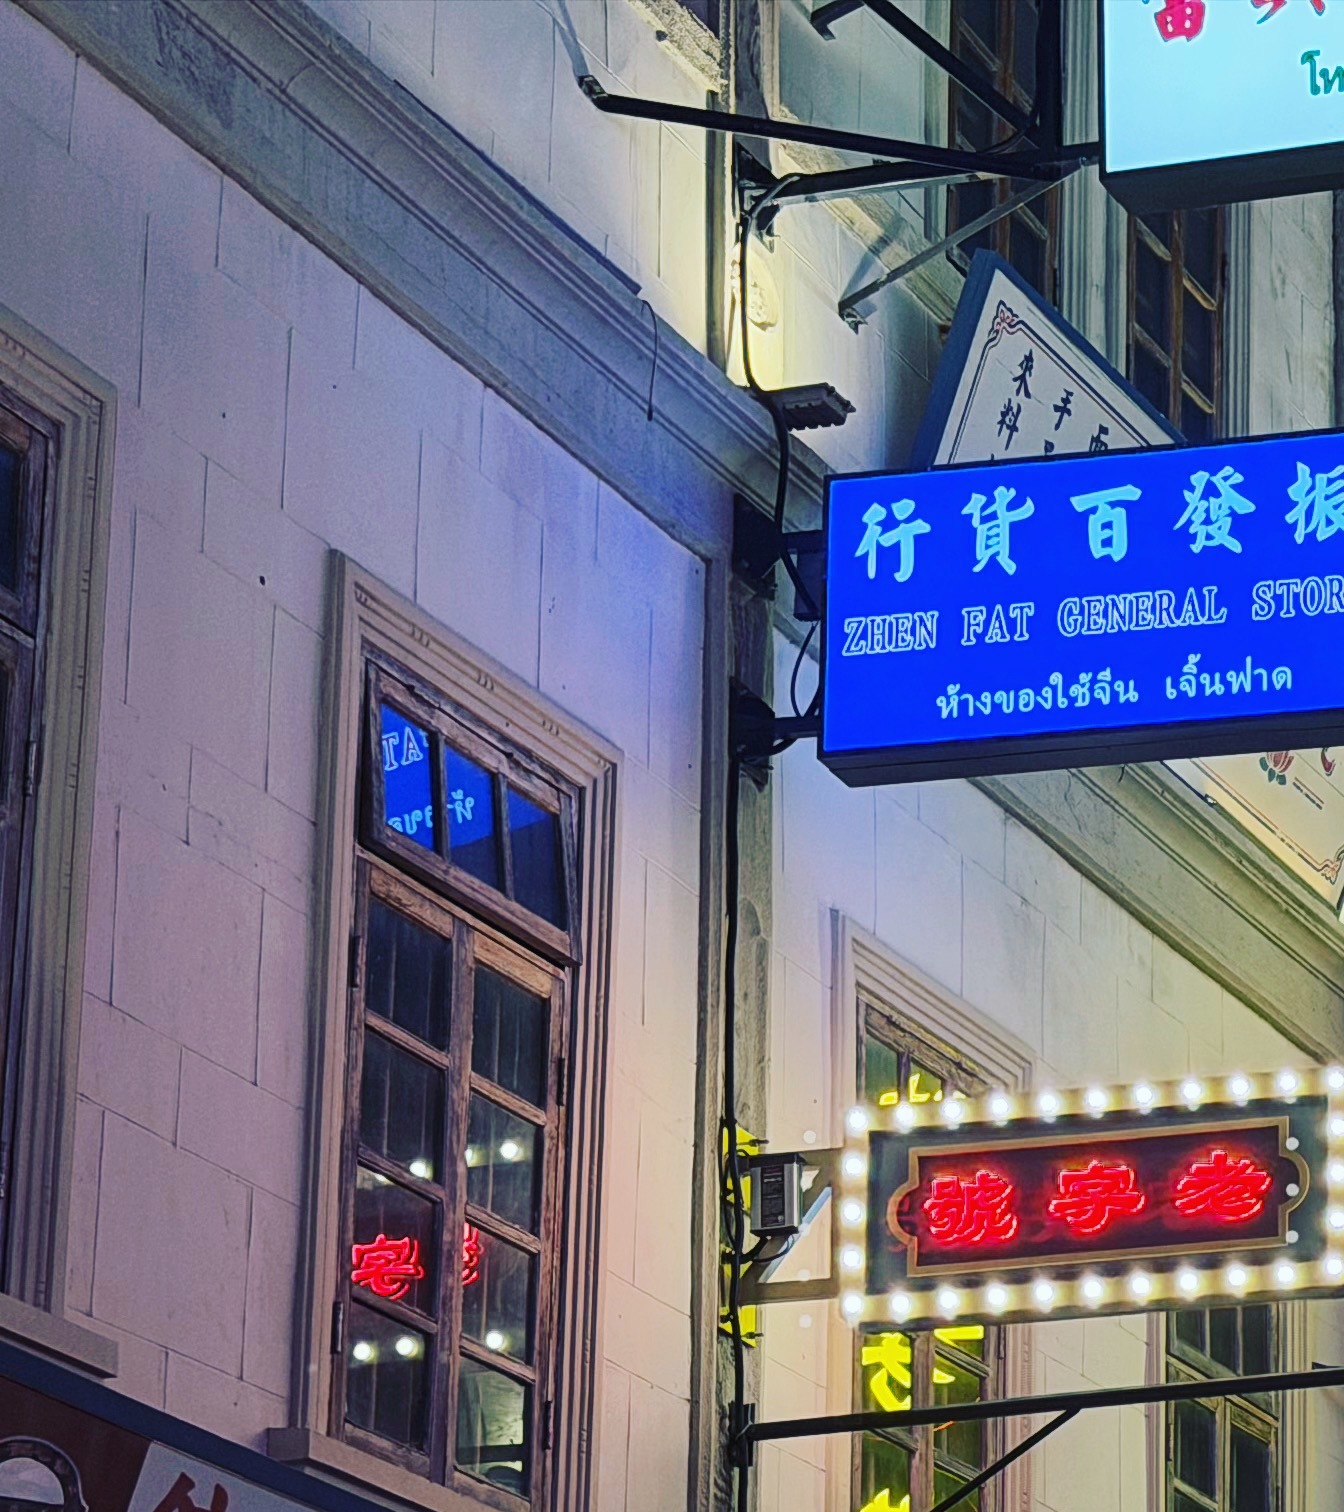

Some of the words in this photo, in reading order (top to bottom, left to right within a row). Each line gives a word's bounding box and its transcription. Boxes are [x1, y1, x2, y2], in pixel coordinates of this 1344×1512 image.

[842, 610, 939, 657] ZHEN
[961, 601, 1035, 648] FAT
[1057, 585, 1227, 638] GENERAL
[936, 666, 1139, 720] ห้างของใช้จีน
[1165, 653, 1293, 702] เจิ้นฟาด
